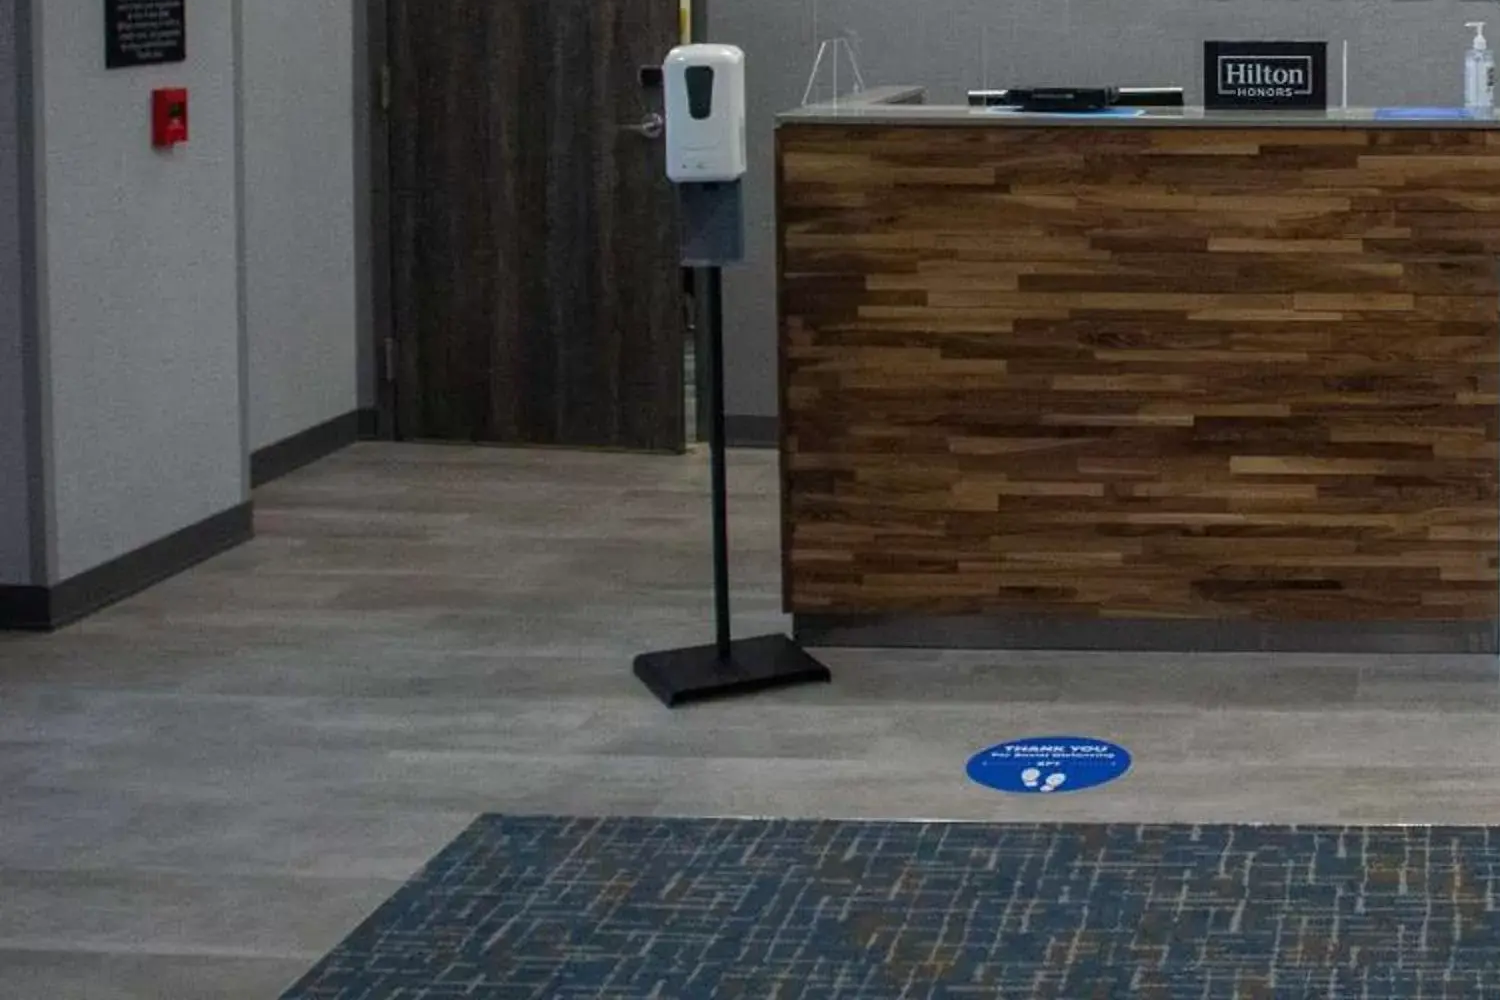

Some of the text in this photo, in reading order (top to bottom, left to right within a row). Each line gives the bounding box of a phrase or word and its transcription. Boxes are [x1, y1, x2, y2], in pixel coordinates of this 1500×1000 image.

[1226, 63, 1304, 85] Hilton
[1237, 88, 1294, 97] HONORS
[1004, 745, 1109, 753] THANK YOU
